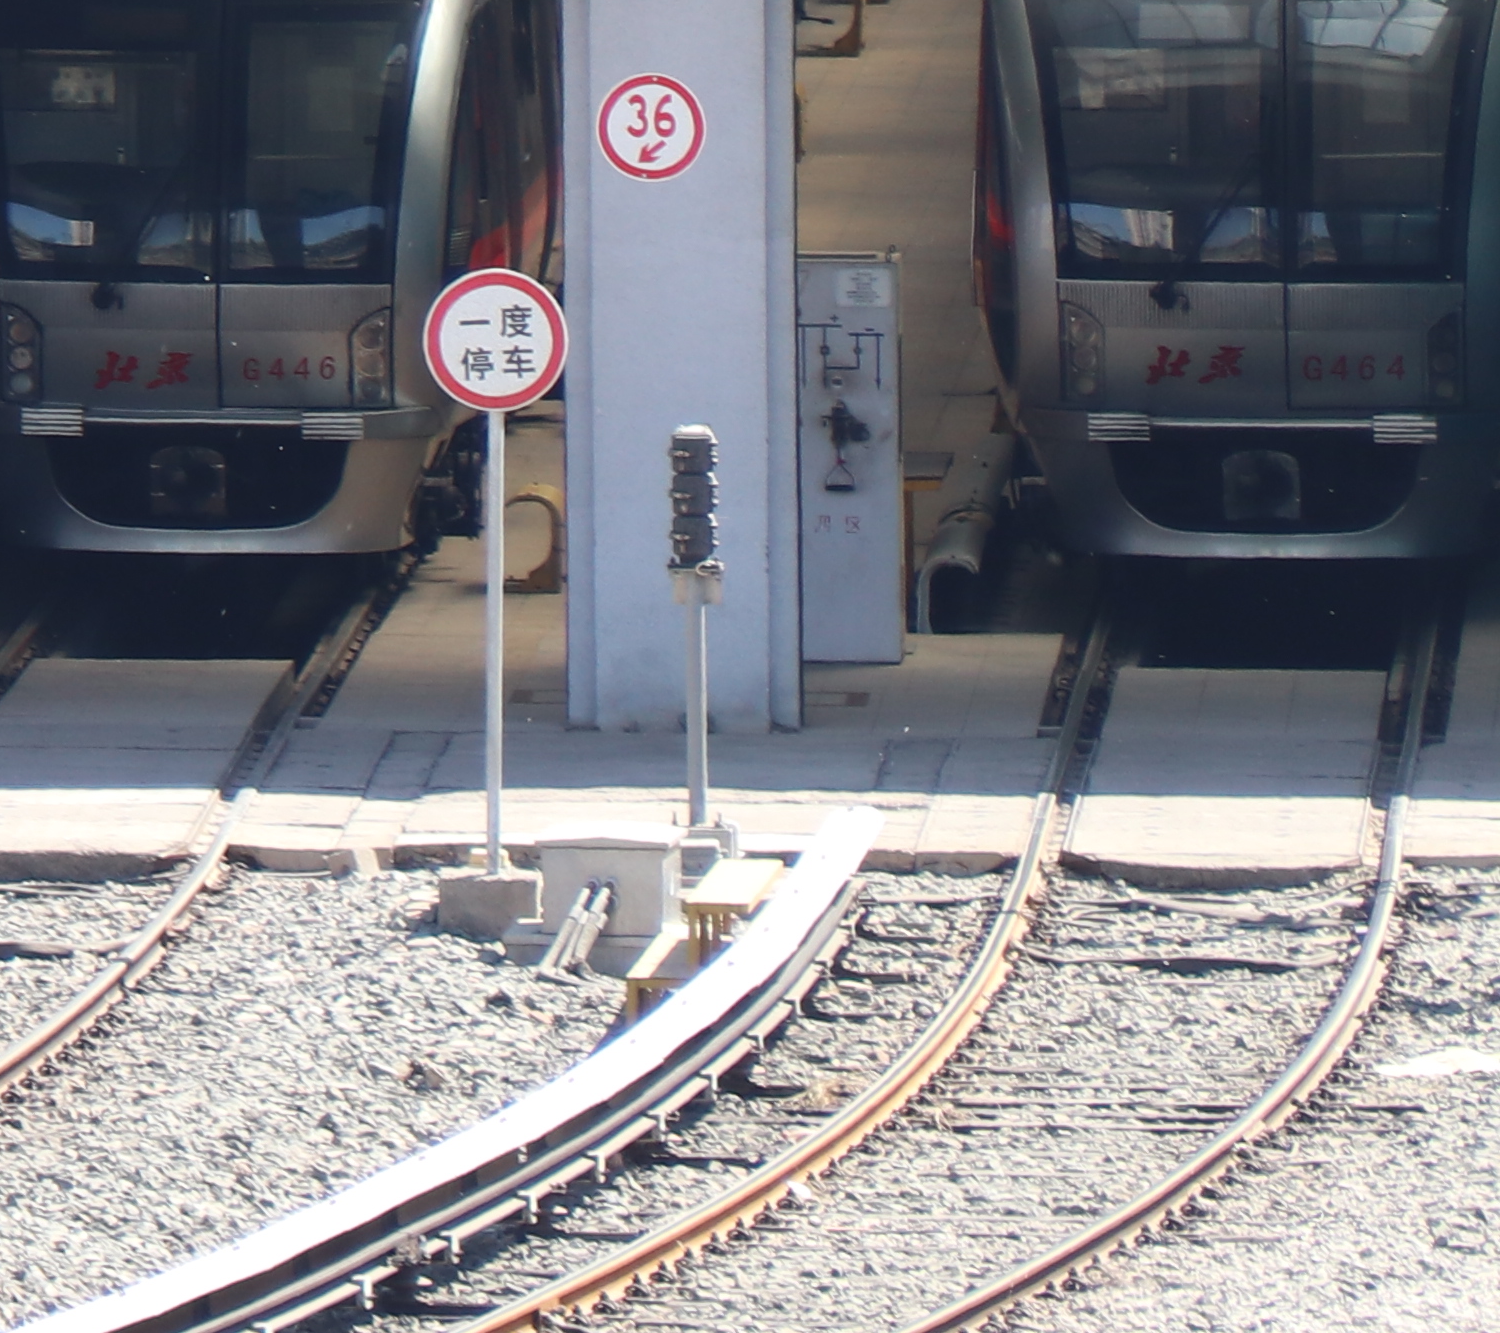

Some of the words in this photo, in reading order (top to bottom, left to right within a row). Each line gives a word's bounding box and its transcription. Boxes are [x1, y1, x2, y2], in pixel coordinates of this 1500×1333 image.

[626, 94, 676, 138] 36
[459, 304, 532, 338] 一度
[95, 351, 193, 389] 北京
[243, 356, 337, 381] G446
[461, 345, 536, 381] 停车
[1146, 345, 1245, 385] 北京
[1303, 354, 1406, 381] G464
